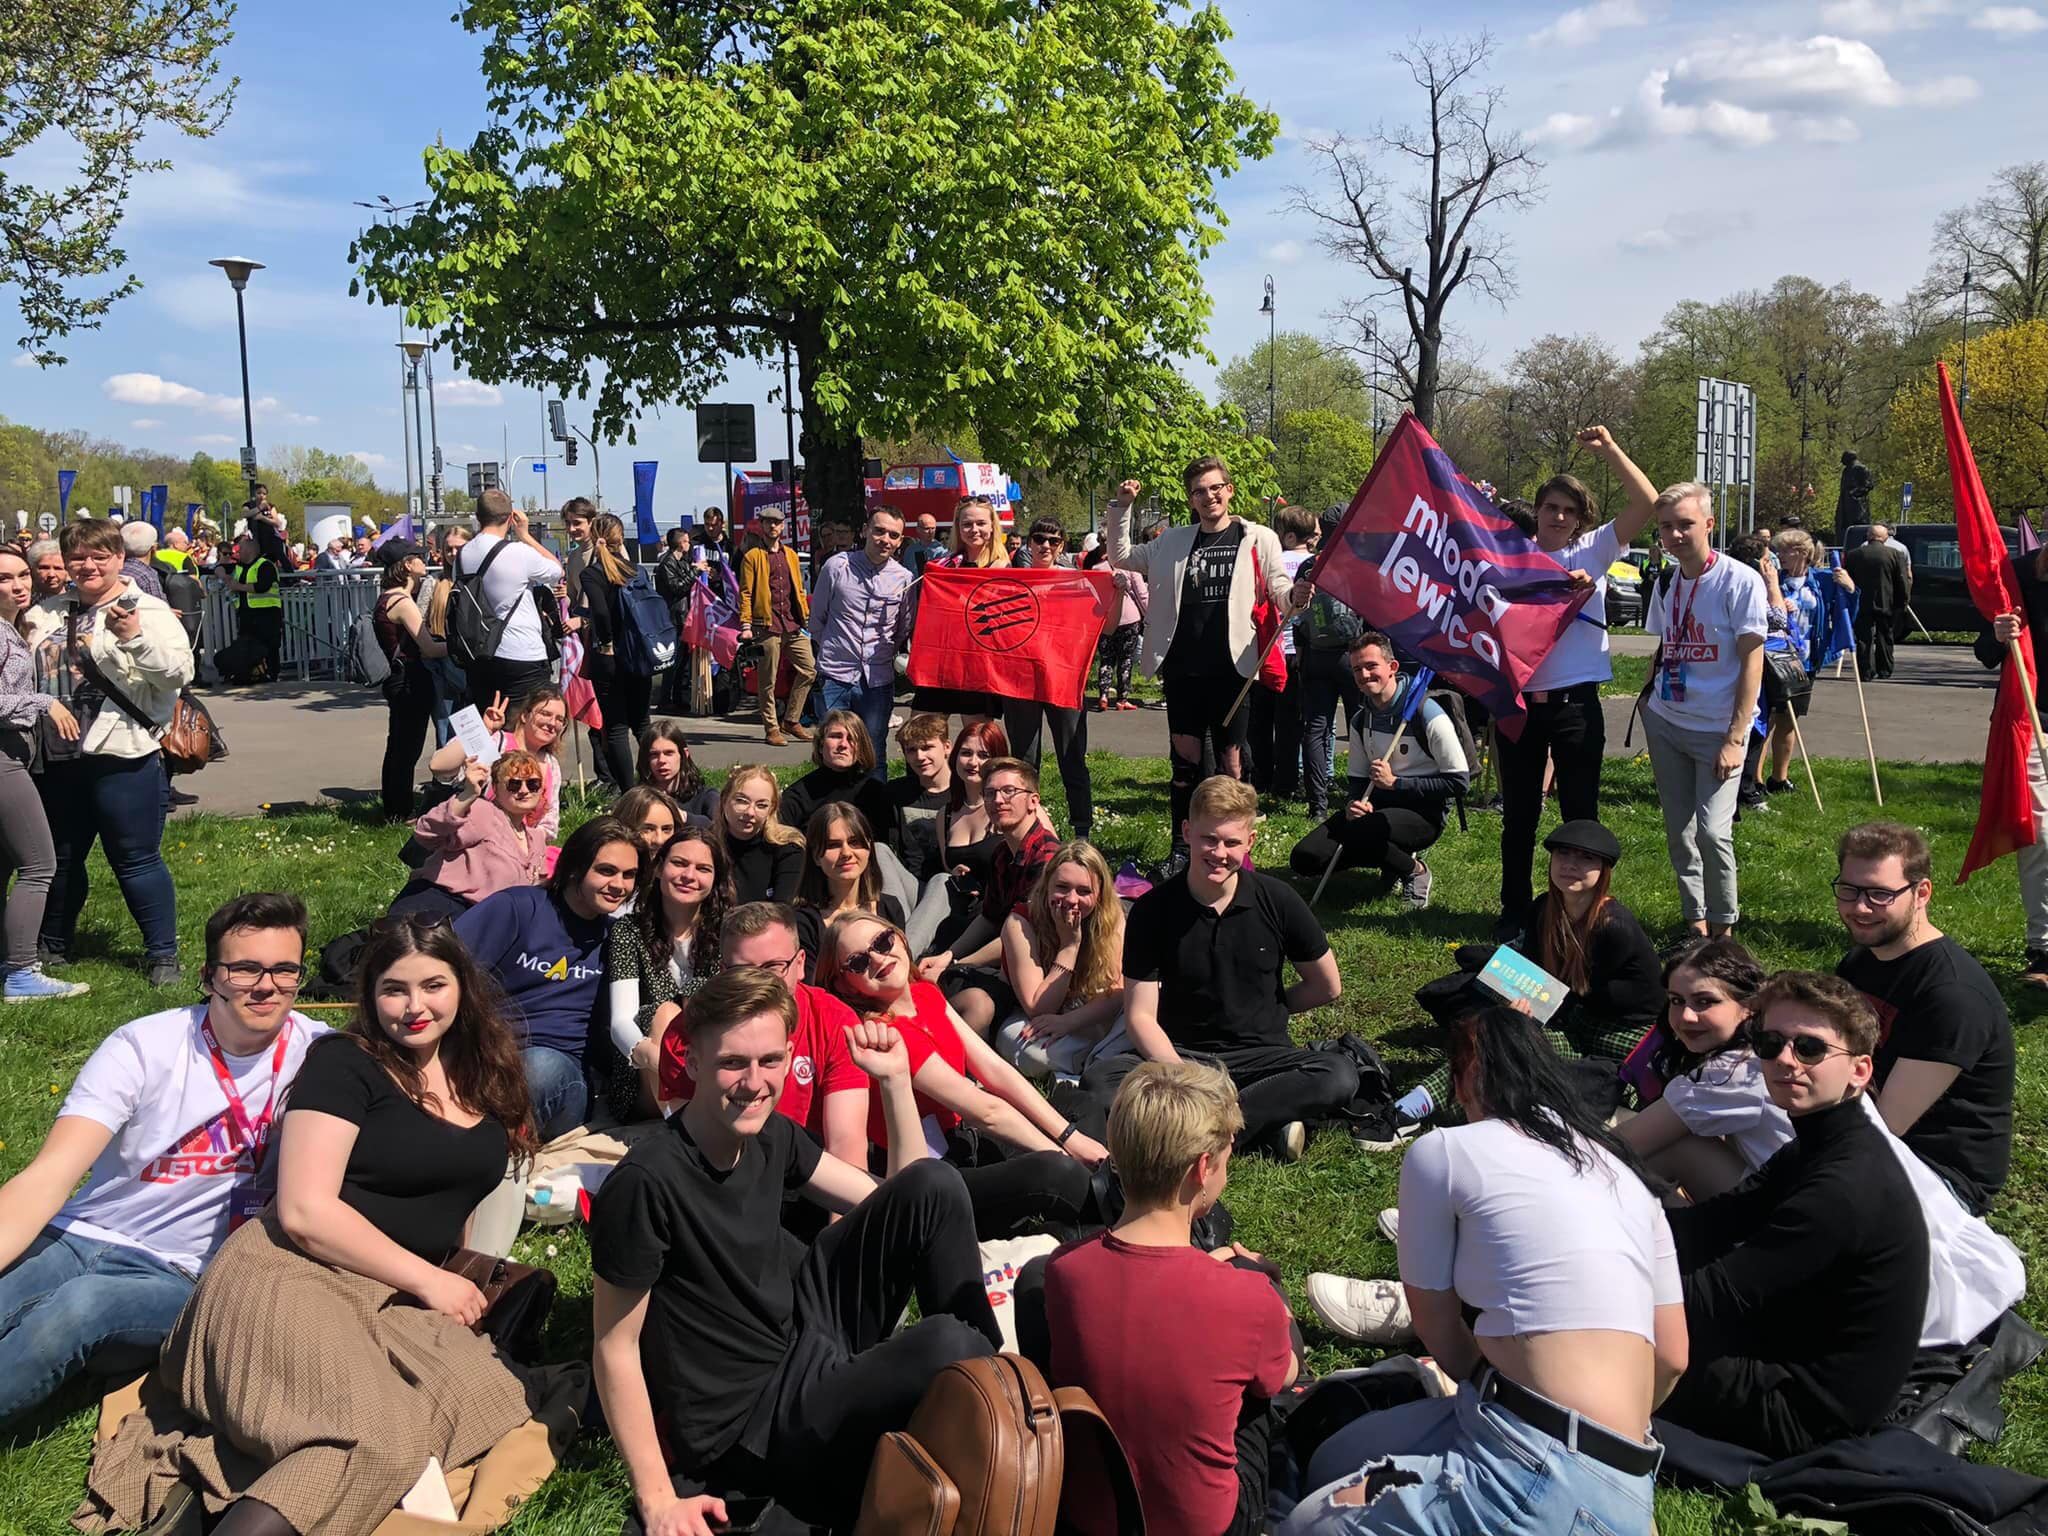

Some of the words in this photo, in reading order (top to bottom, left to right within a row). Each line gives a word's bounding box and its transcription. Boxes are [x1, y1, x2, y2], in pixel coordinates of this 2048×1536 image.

[1378, 531, 1500, 671] lewica
[1403, 494, 1512, 627] młoda
[150, 1151, 256, 1179] LECA
